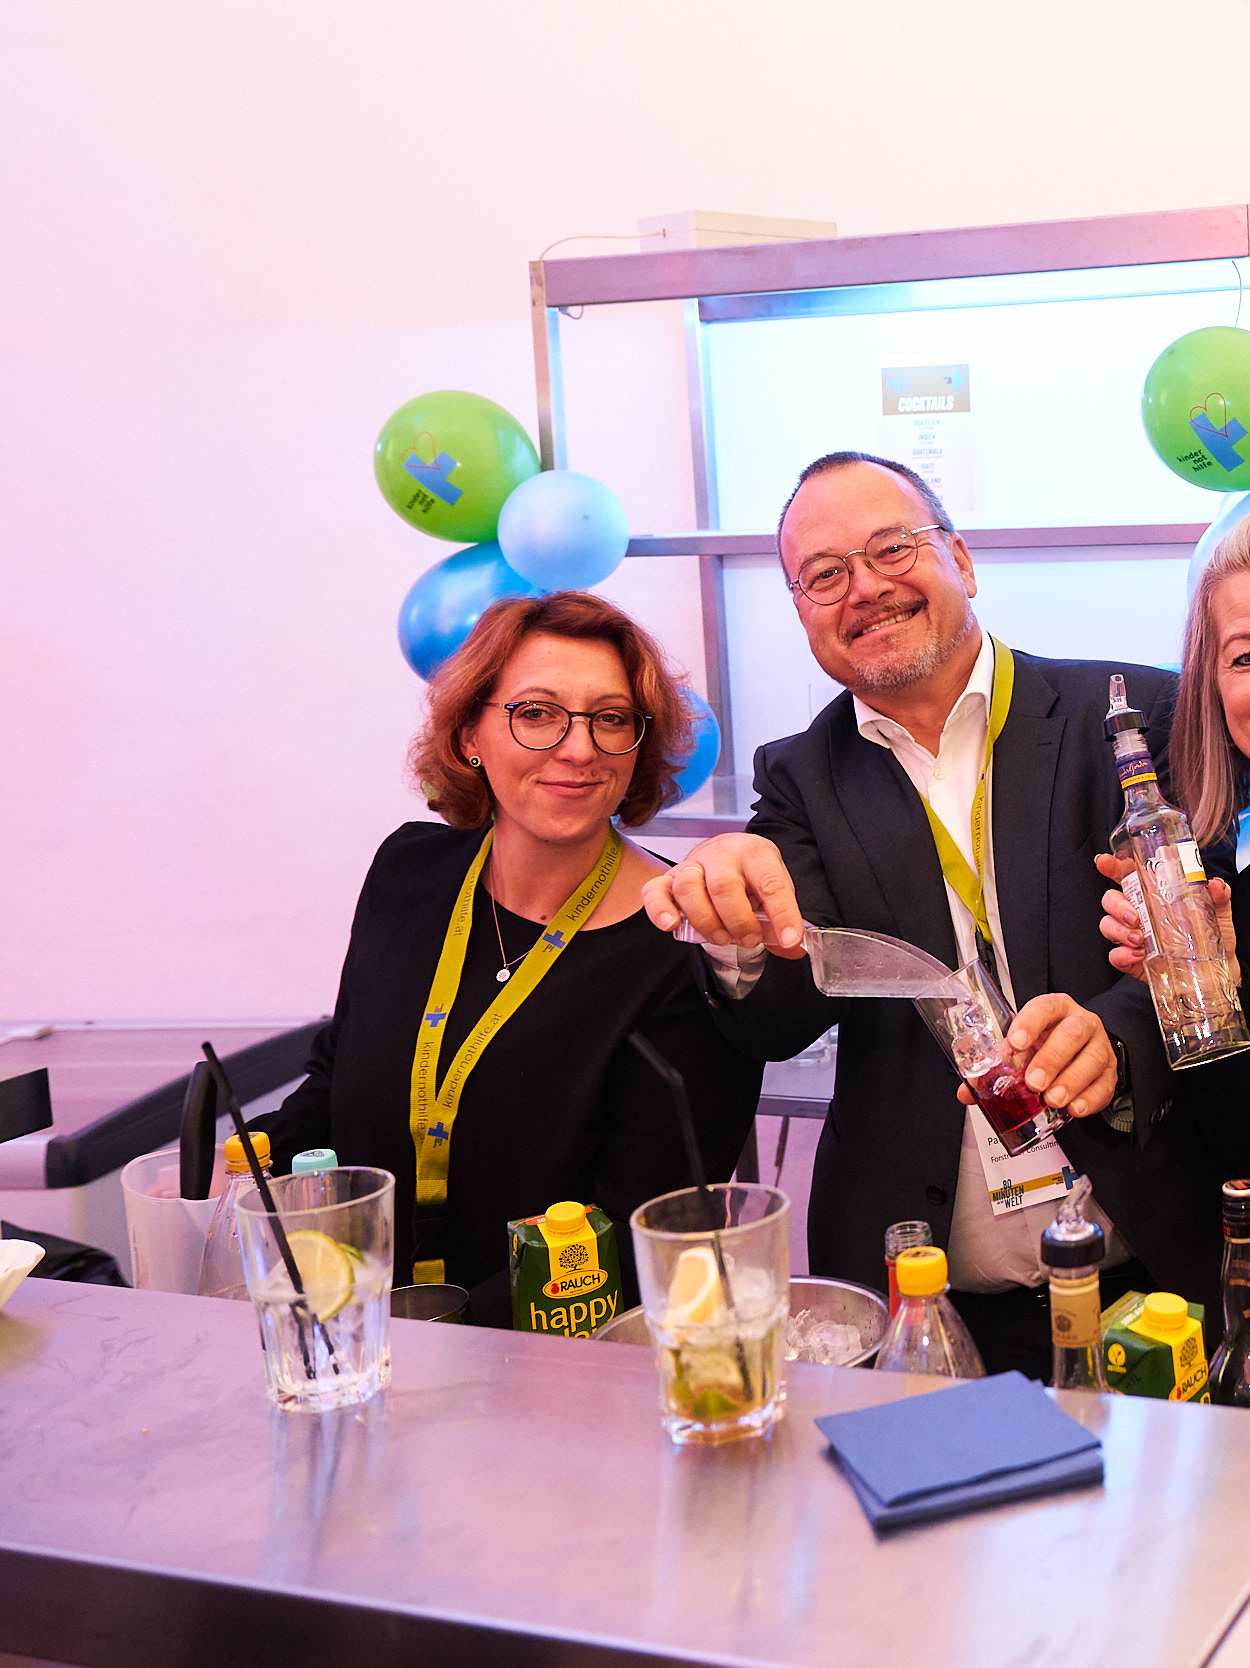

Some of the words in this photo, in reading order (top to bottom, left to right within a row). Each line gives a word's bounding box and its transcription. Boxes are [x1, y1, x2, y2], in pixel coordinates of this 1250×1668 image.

[898, 396, 955, 412] COCKTAILS
[1176, 449, 1202, 462] kinder
[1193, 455, 1207, 464] not
[1192, 461, 1213, 472] hilfe
[442, 1013, 502, 1108] kindernothilfe.at
[987, 1137, 1000, 1146] Pa
[1002, 1179, 1012, 1189] 80
[992, 1184, 1025, 1202] MINUTEN
[1004, 1195, 1023, 1209] WELT
[560, 1273, 601, 1292] RAUCH
[530, 1289, 618, 1333] happy
[1182, 1365, 1208, 1394] RAUCH
